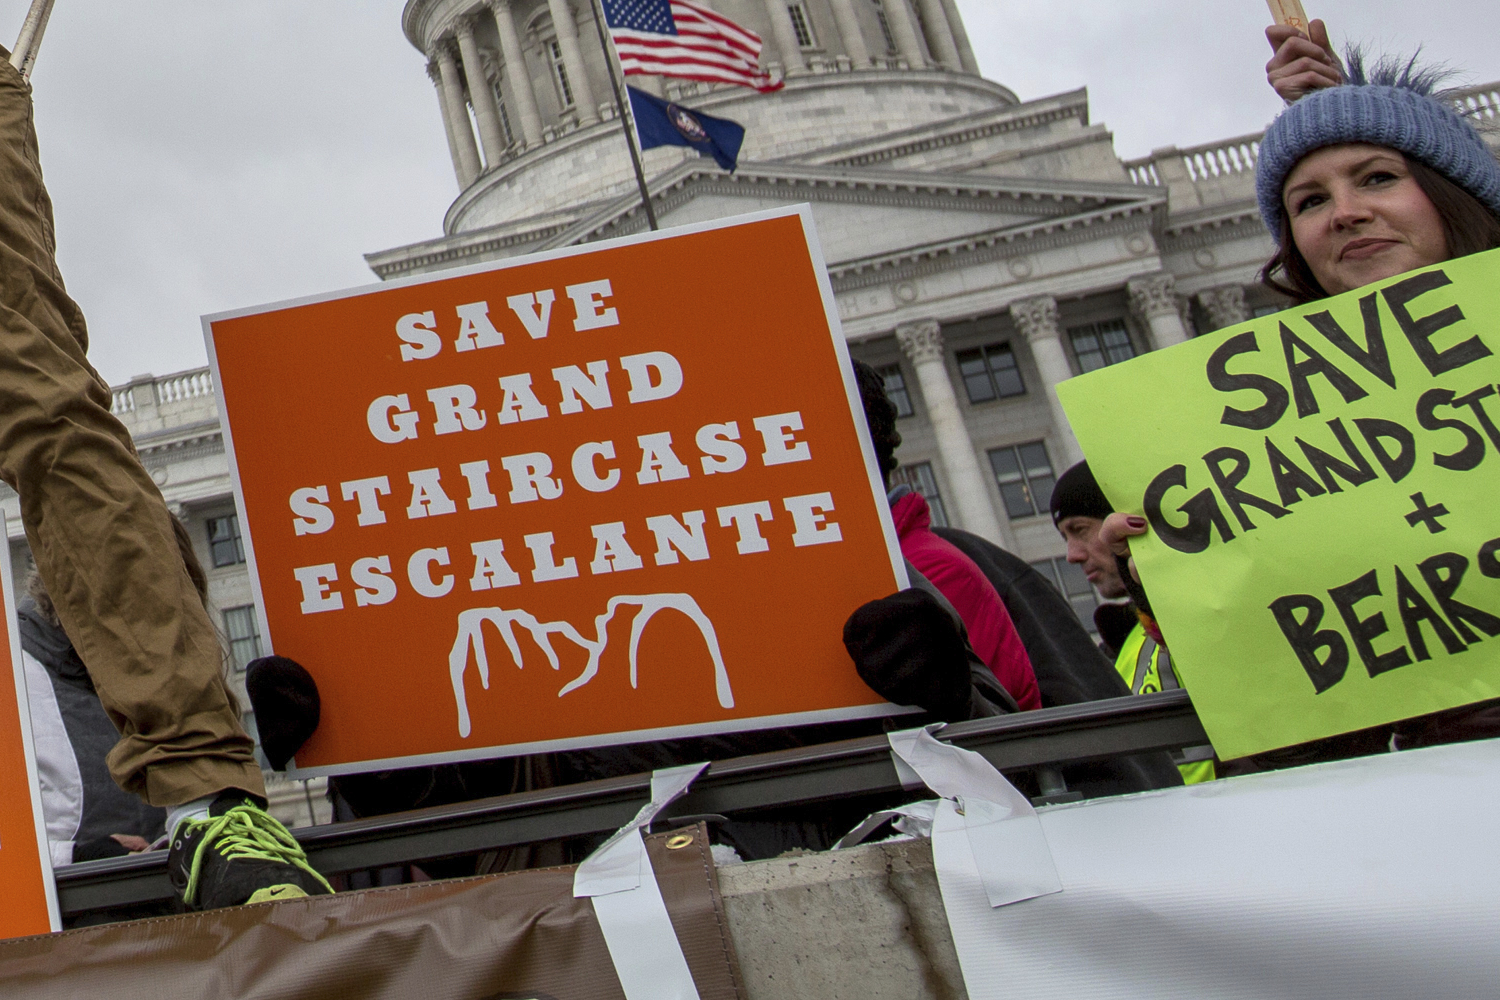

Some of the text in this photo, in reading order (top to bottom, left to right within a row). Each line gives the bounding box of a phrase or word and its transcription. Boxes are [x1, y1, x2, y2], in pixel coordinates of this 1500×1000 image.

[395, 278, 620, 362] SAVE
[1206, 270, 1494, 431] SAVE
[367, 350, 684, 444] GRAND
[290, 411, 812, 537] STAIRCASE
[1143, 383, 1500, 554] GRANDST
[294, 491, 843, 615] ESCALANTE
